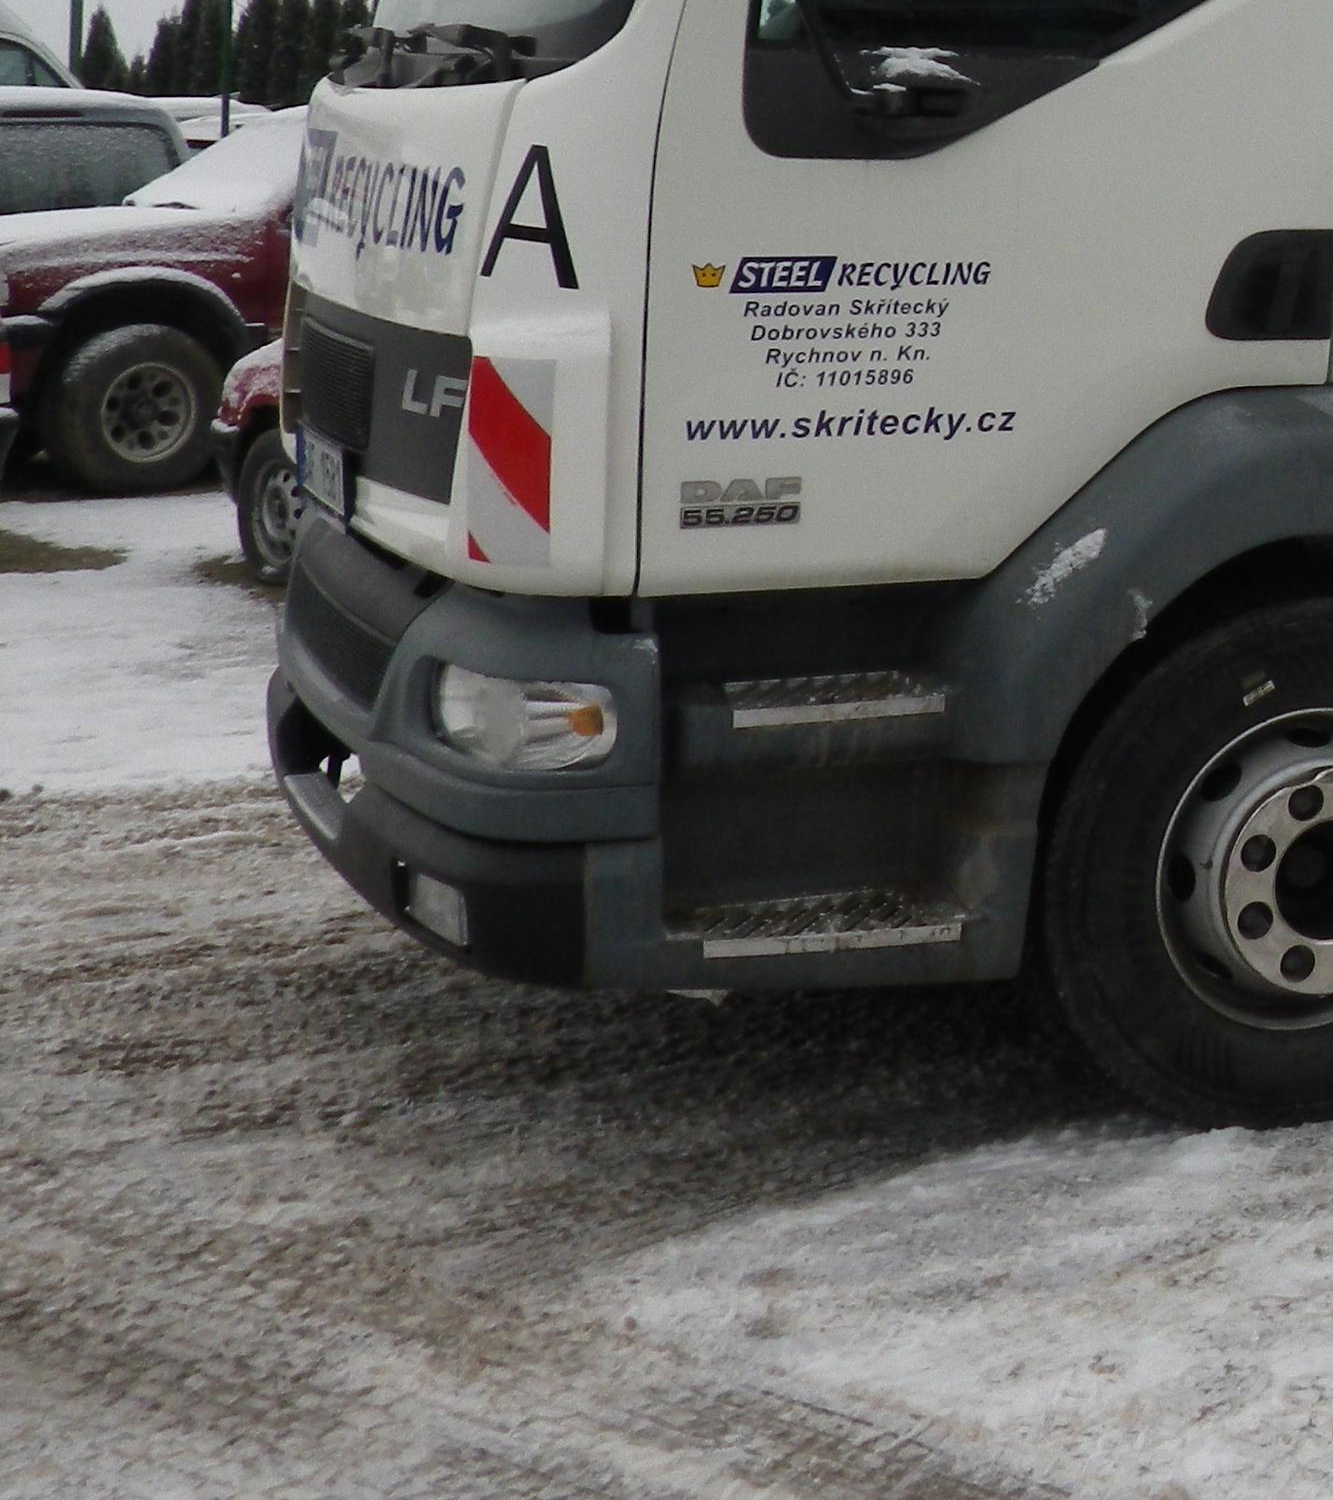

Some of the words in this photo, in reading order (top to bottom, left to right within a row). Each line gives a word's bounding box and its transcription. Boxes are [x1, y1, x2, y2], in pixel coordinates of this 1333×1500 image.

[480, 143, 579, 290] A
[738, 261, 823, 288] STEEL
[837, 261, 991, 291] RECYCLING
[744, 301, 840, 317] Radovan
[849, 298, 949, 318] Skřítecký
[751, 322, 897, 341] Dobrovského
[905, 321, 941, 338] 333
[765, 348, 862, 368] Rychnov
[870, 350, 887, 362] n.
[897, 345, 930, 361] Kn.
[776, 367, 806, 388] IČ:
[816, 368, 914, 387] 11015896
[402, 368, 469, 418] LF
[685, 406, 1017, 441] www.skritecky.cz
[681, 477, 801, 504] DAF
[681, 505, 800, 529] 55.250
